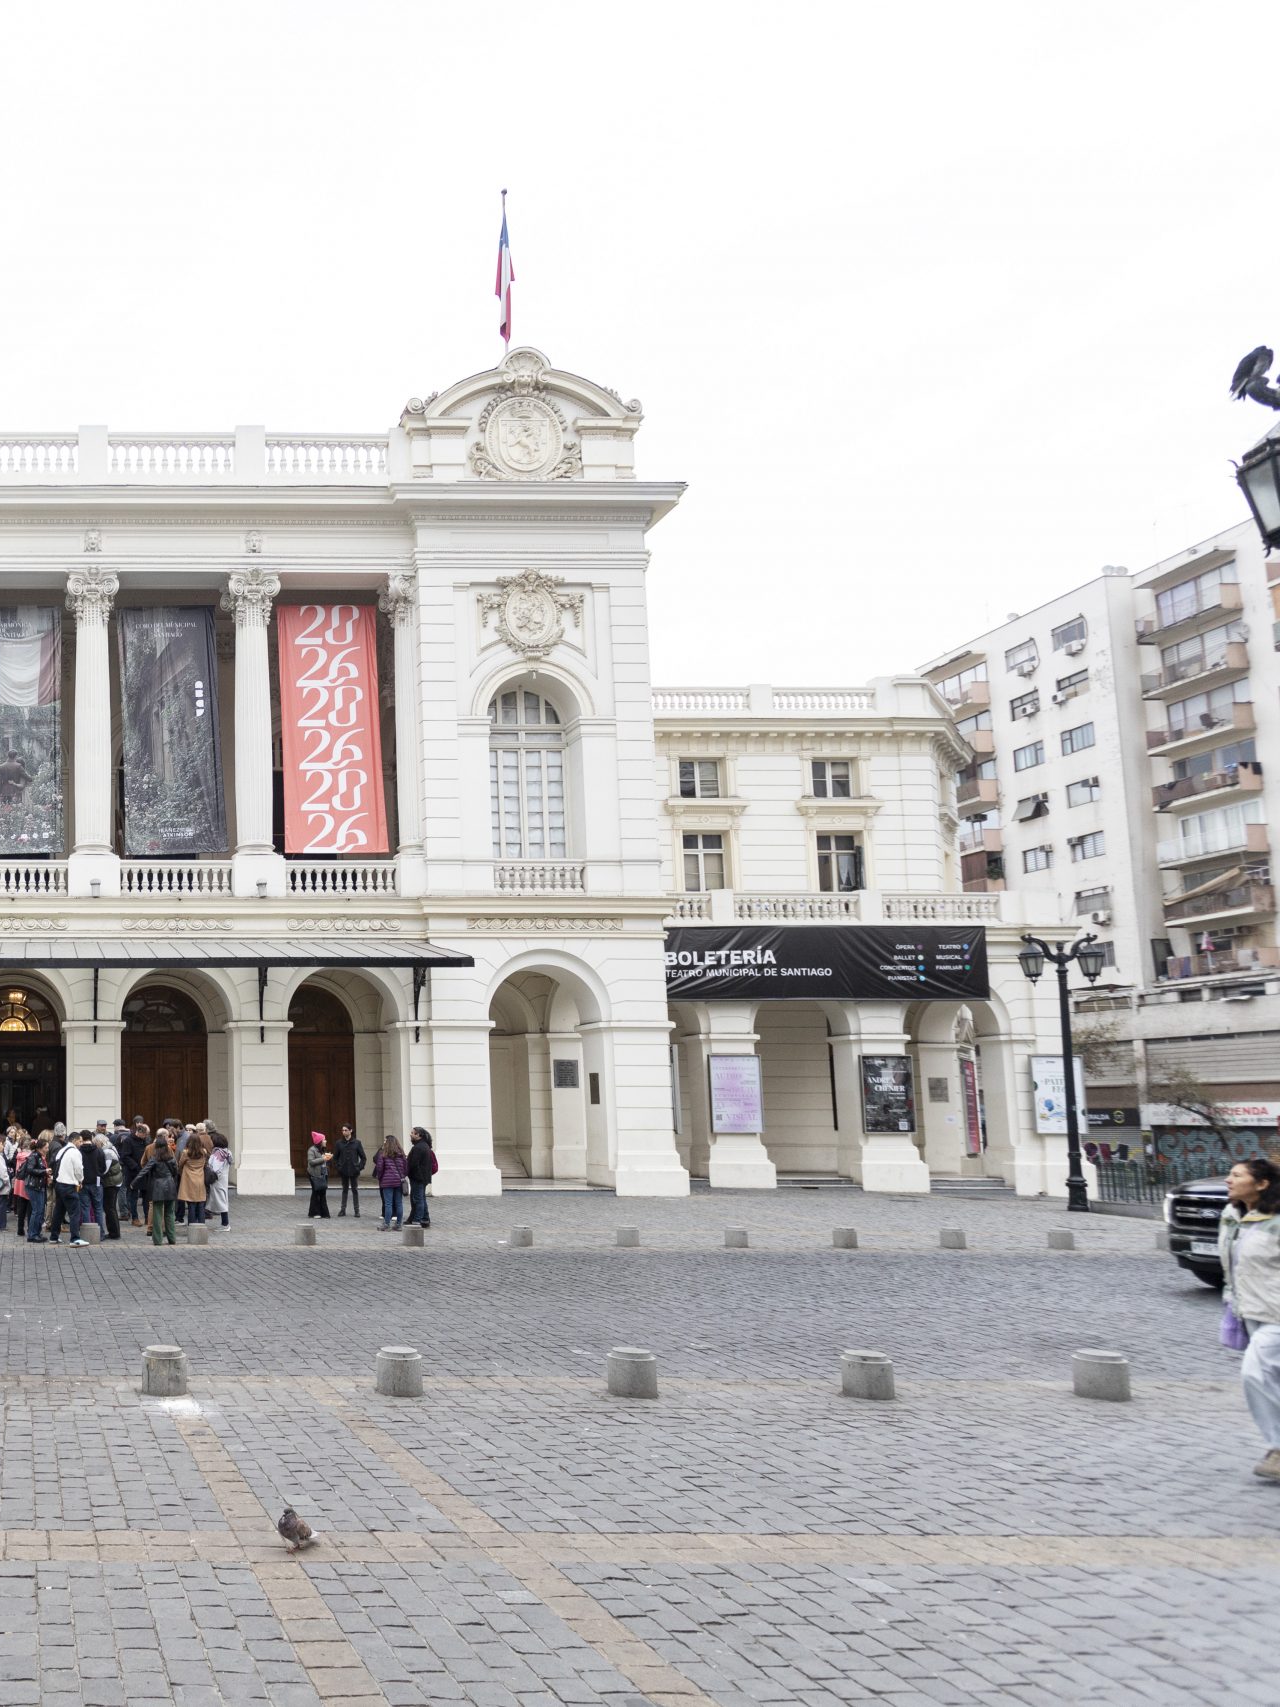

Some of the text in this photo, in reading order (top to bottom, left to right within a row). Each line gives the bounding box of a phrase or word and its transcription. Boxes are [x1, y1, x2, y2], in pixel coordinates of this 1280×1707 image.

[295, 605, 359, 645] 20
[296, 646, 361, 687] 26
[297, 686, 363, 727] 20
[299, 728, 364, 770] 26
[301, 769, 367, 811] 20
[303, 812, 369, 853] 26
[665, 946, 777, 966] BOLETERÍA
[666, 967, 833, 978] TEATRO MUNICIPAL DE SANTIAGO
